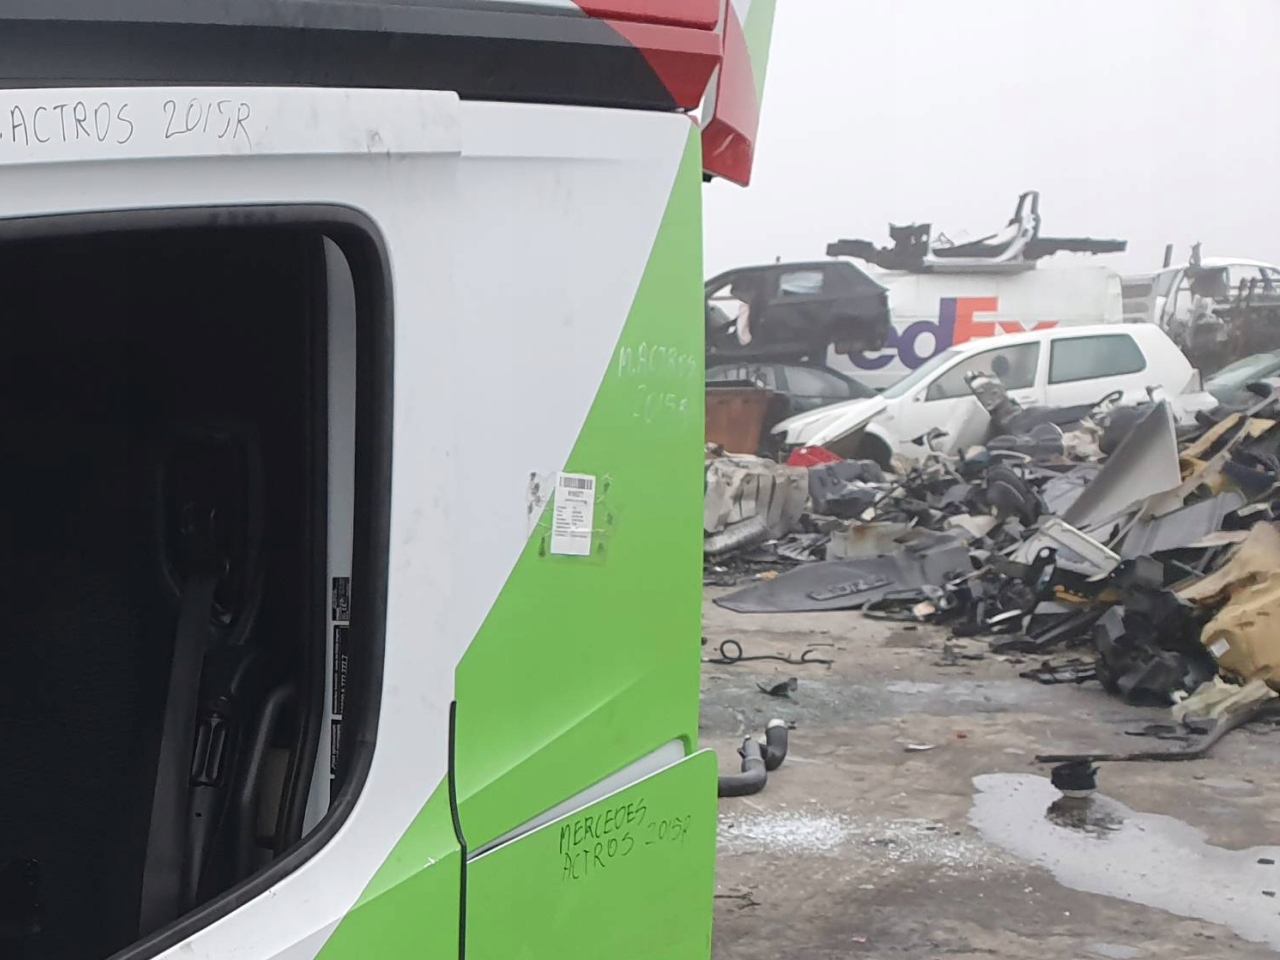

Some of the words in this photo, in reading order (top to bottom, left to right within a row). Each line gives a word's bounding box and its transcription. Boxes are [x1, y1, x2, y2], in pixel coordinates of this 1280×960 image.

[164, 97, 252, 150] 2015R
[559, 798, 647, 854] MERCEDES
[562, 832, 634, 881] ACTROS
